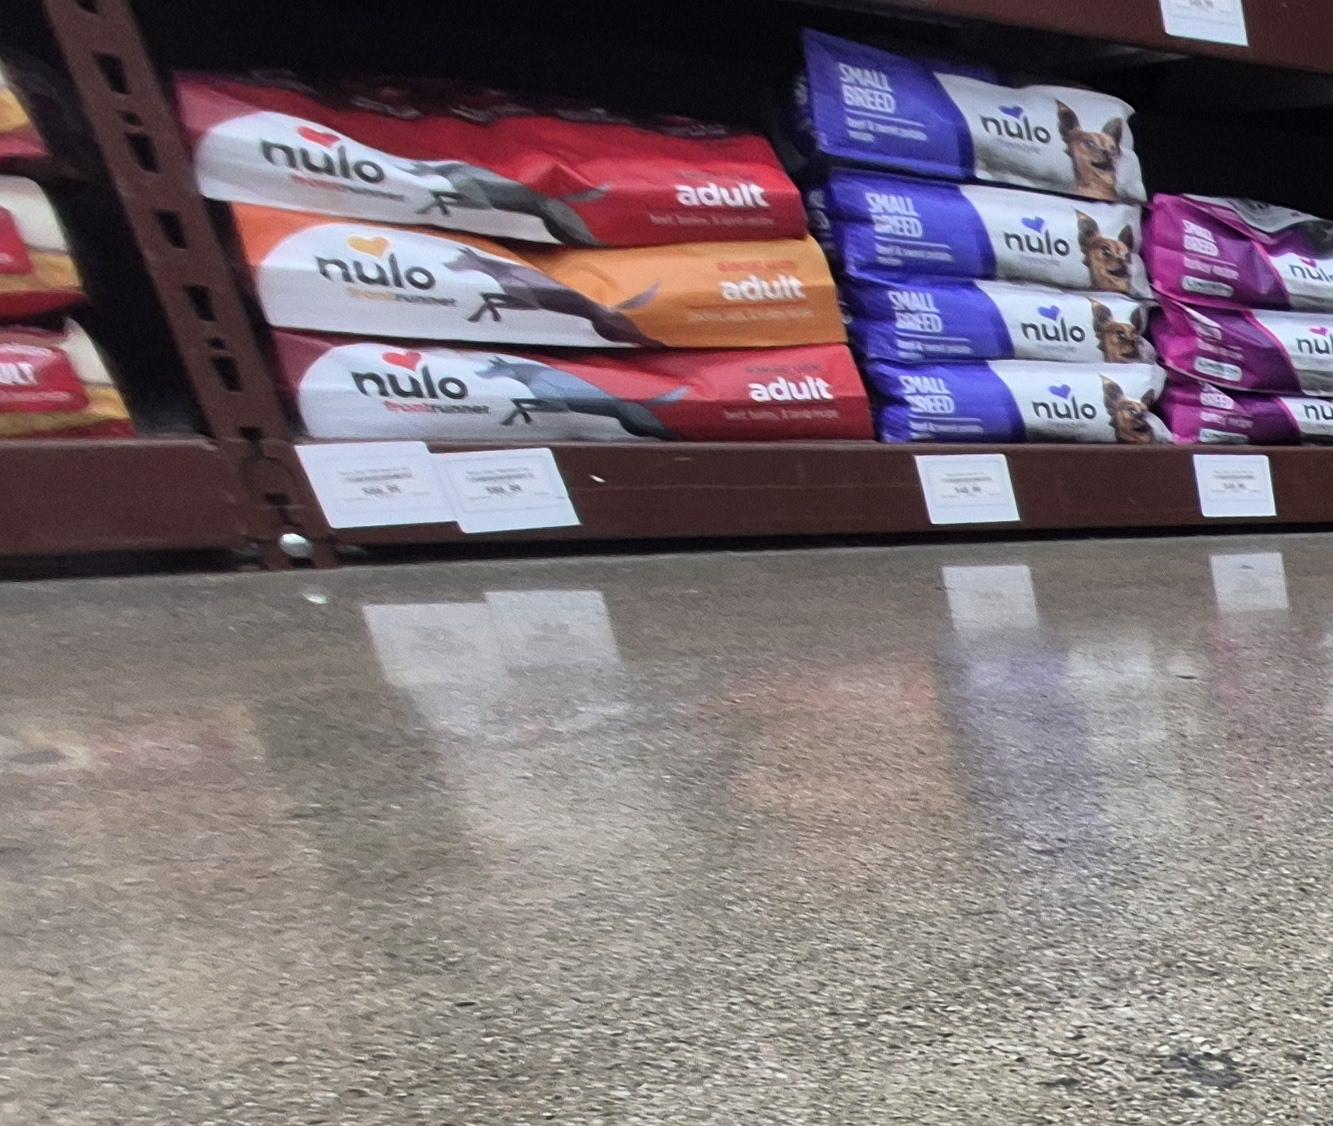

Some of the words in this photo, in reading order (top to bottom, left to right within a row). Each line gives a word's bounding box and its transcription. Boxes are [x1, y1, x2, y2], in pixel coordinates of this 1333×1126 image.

[838, 62, 893, 92] SMALL
[842, 84, 896, 114] BREED
[981, 115, 1050, 144] nulo
[261, 140, 385, 184] nulo
[675, 182, 769, 209] adult
[865, 192, 920, 218] SMALL
[1004, 229, 1070, 256] nulo
[316, 253, 435, 290] nulo
[720, 274, 806, 301] adult
[888, 290, 940, 313] SMALL
[1021, 318, 1085, 343] nulo
[352, 366, 468, 400] nulo
[748, 375, 833, 402] adult
[900, 376, 952, 395] SMALL
[1032, 396, 1097, 420] nulo
